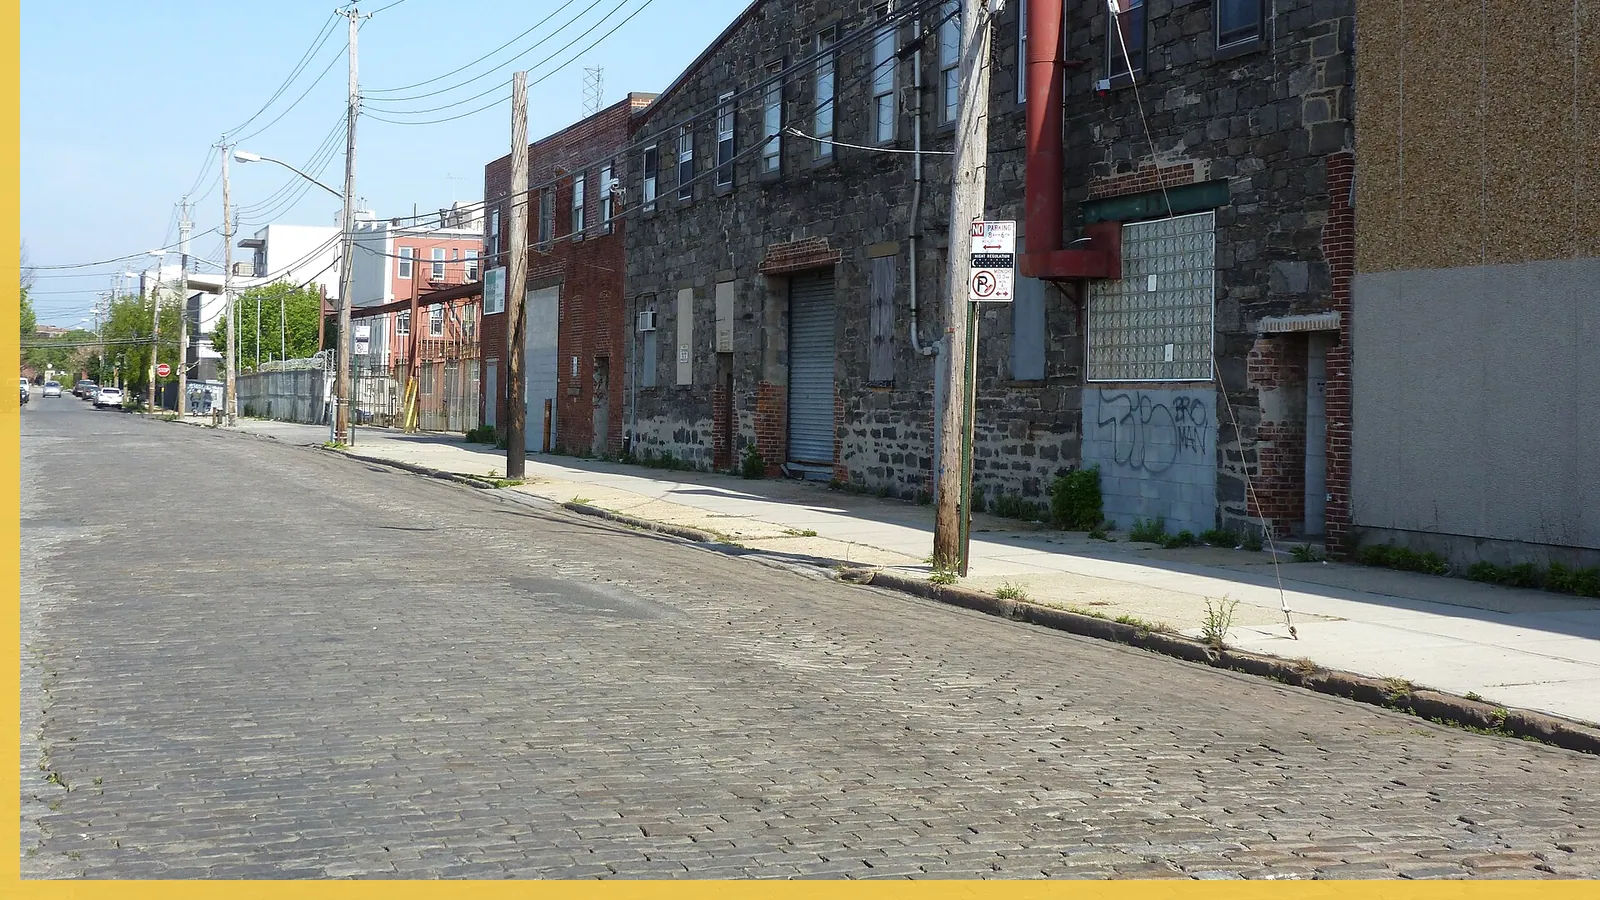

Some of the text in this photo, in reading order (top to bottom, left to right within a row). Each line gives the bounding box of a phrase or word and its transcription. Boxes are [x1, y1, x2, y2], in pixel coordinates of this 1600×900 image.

[972, 224, 984, 235] NO
[1172, 395, 1207, 426] BRO
[1178, 419, 1208, 455] MAN
